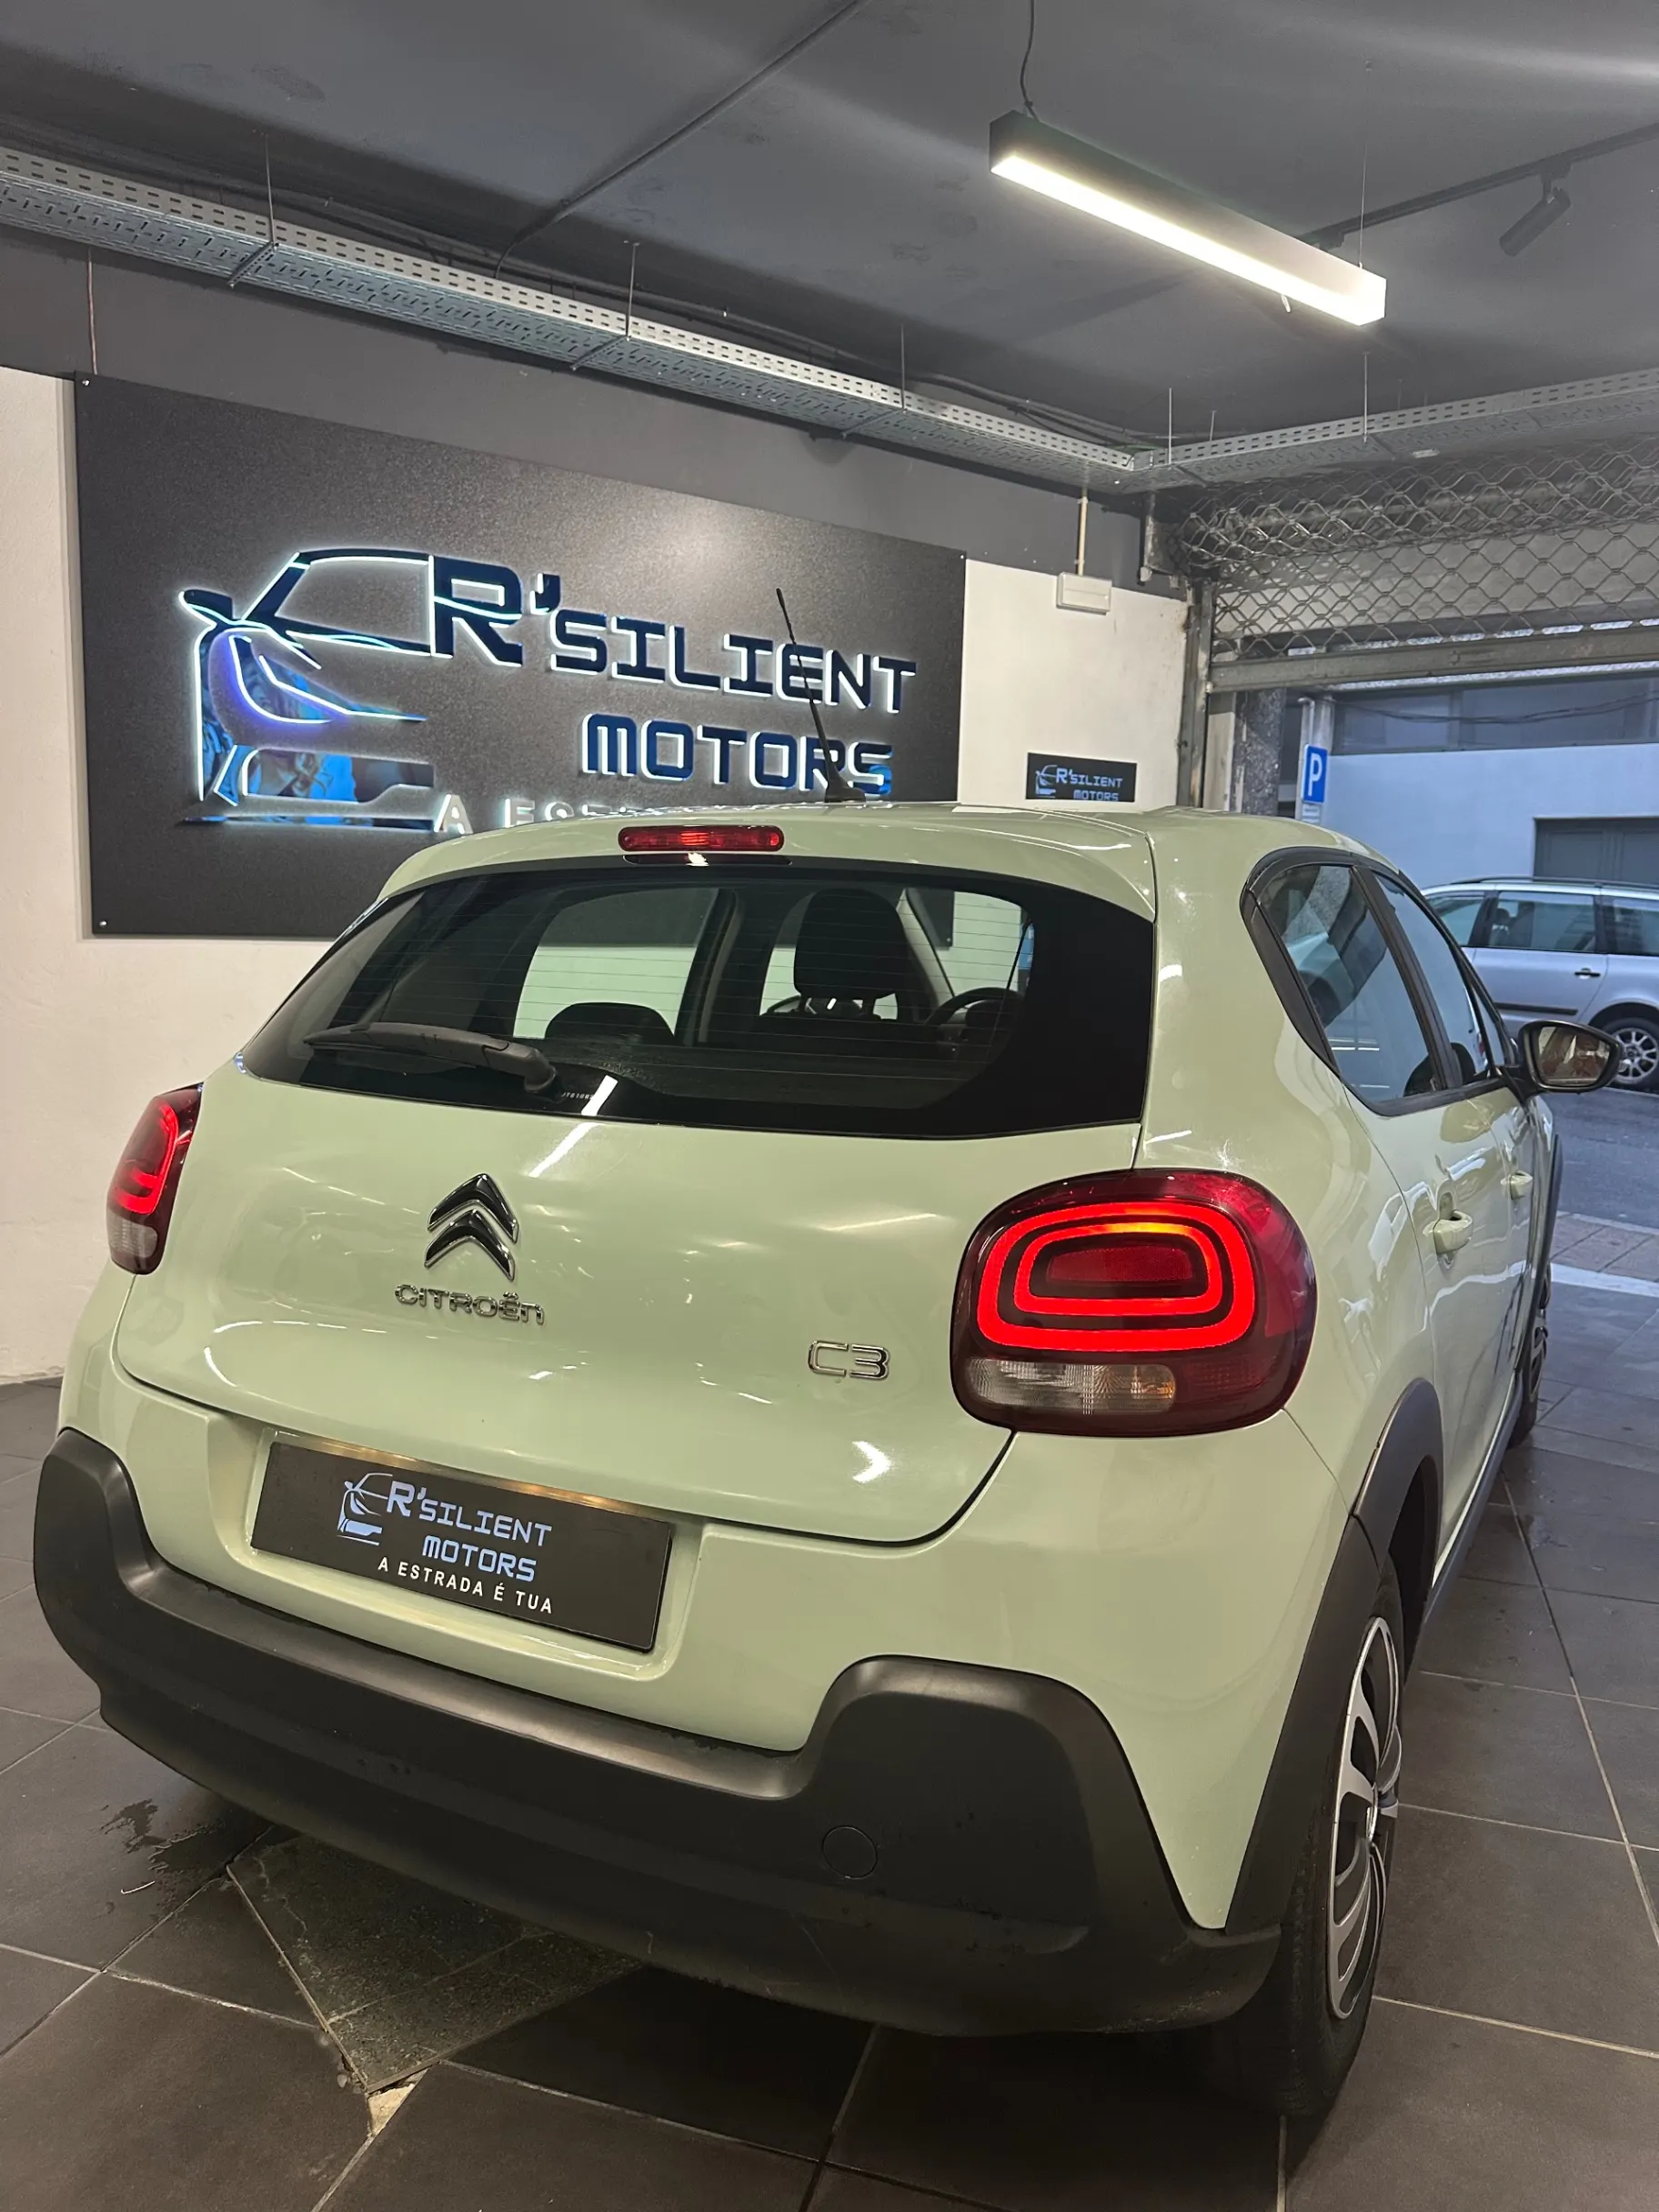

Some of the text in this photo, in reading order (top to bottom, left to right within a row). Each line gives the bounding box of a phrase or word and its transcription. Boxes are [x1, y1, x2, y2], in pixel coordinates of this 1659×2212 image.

[581, 713, 894, 797] MOTORS
[1308, 752, 1322, 797] P
[434, 793, 474, 835] A
[1073, 789, 1119, 802] MOTORS
[807, 1339, 890, 1381] C3
[387, 1481, 552, 1547] R'SILIENT
[422, 1534, 538, 1583] MOTORS
[377, 1557, 553, 1614] A ESTRADA É TUA
